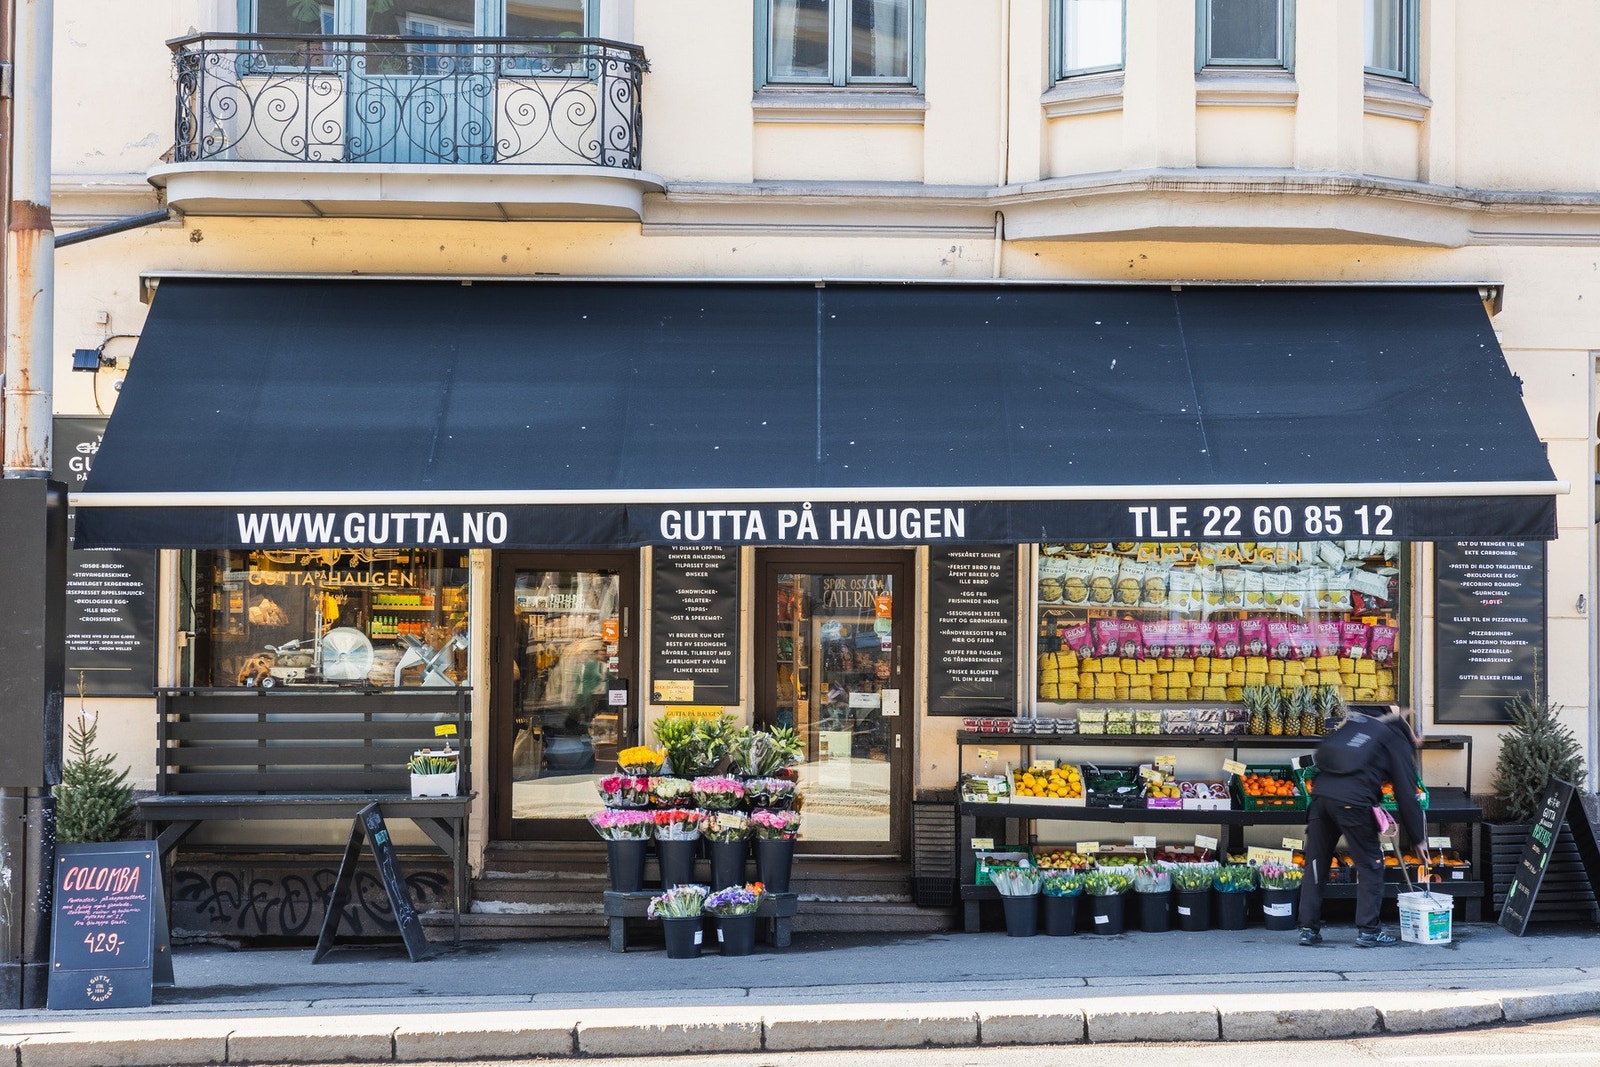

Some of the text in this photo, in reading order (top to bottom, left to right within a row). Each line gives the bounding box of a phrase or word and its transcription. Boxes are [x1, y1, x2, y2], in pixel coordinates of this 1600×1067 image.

[237, 512, 508, 543] WWW.GUTTA.NO
[660, 502, 965, 540] GUTTA PÅ HAUGEN
[1128, 505, 1393, 537] TLF. 22 60 85 12
[1138, 548, 1203, 562] GUTTA
[1216, 547, 1302, 564] HAUGEN
[248, 571, 315, 586] GUTTA
[315, 569, 328, 580] PÅ
[328, 571, 414, 587] HAUGEN
[824, 578, 846, 590] SPØR
[850, 579, 866, 590] OSS
[1120, 622, 1137, 631] REAL
[1242, 621, 1263, 629] REAL
[1344, 624, 1364, 632] REAL
[1374, 627, 1392, 636] REAL
[1065, 627, 1085, 640] REAL
[62, 866, 140, 896] COLOMBA
[84, 932, 125, 956] 429,-
[90, 975, 110, 984] GUTTA
